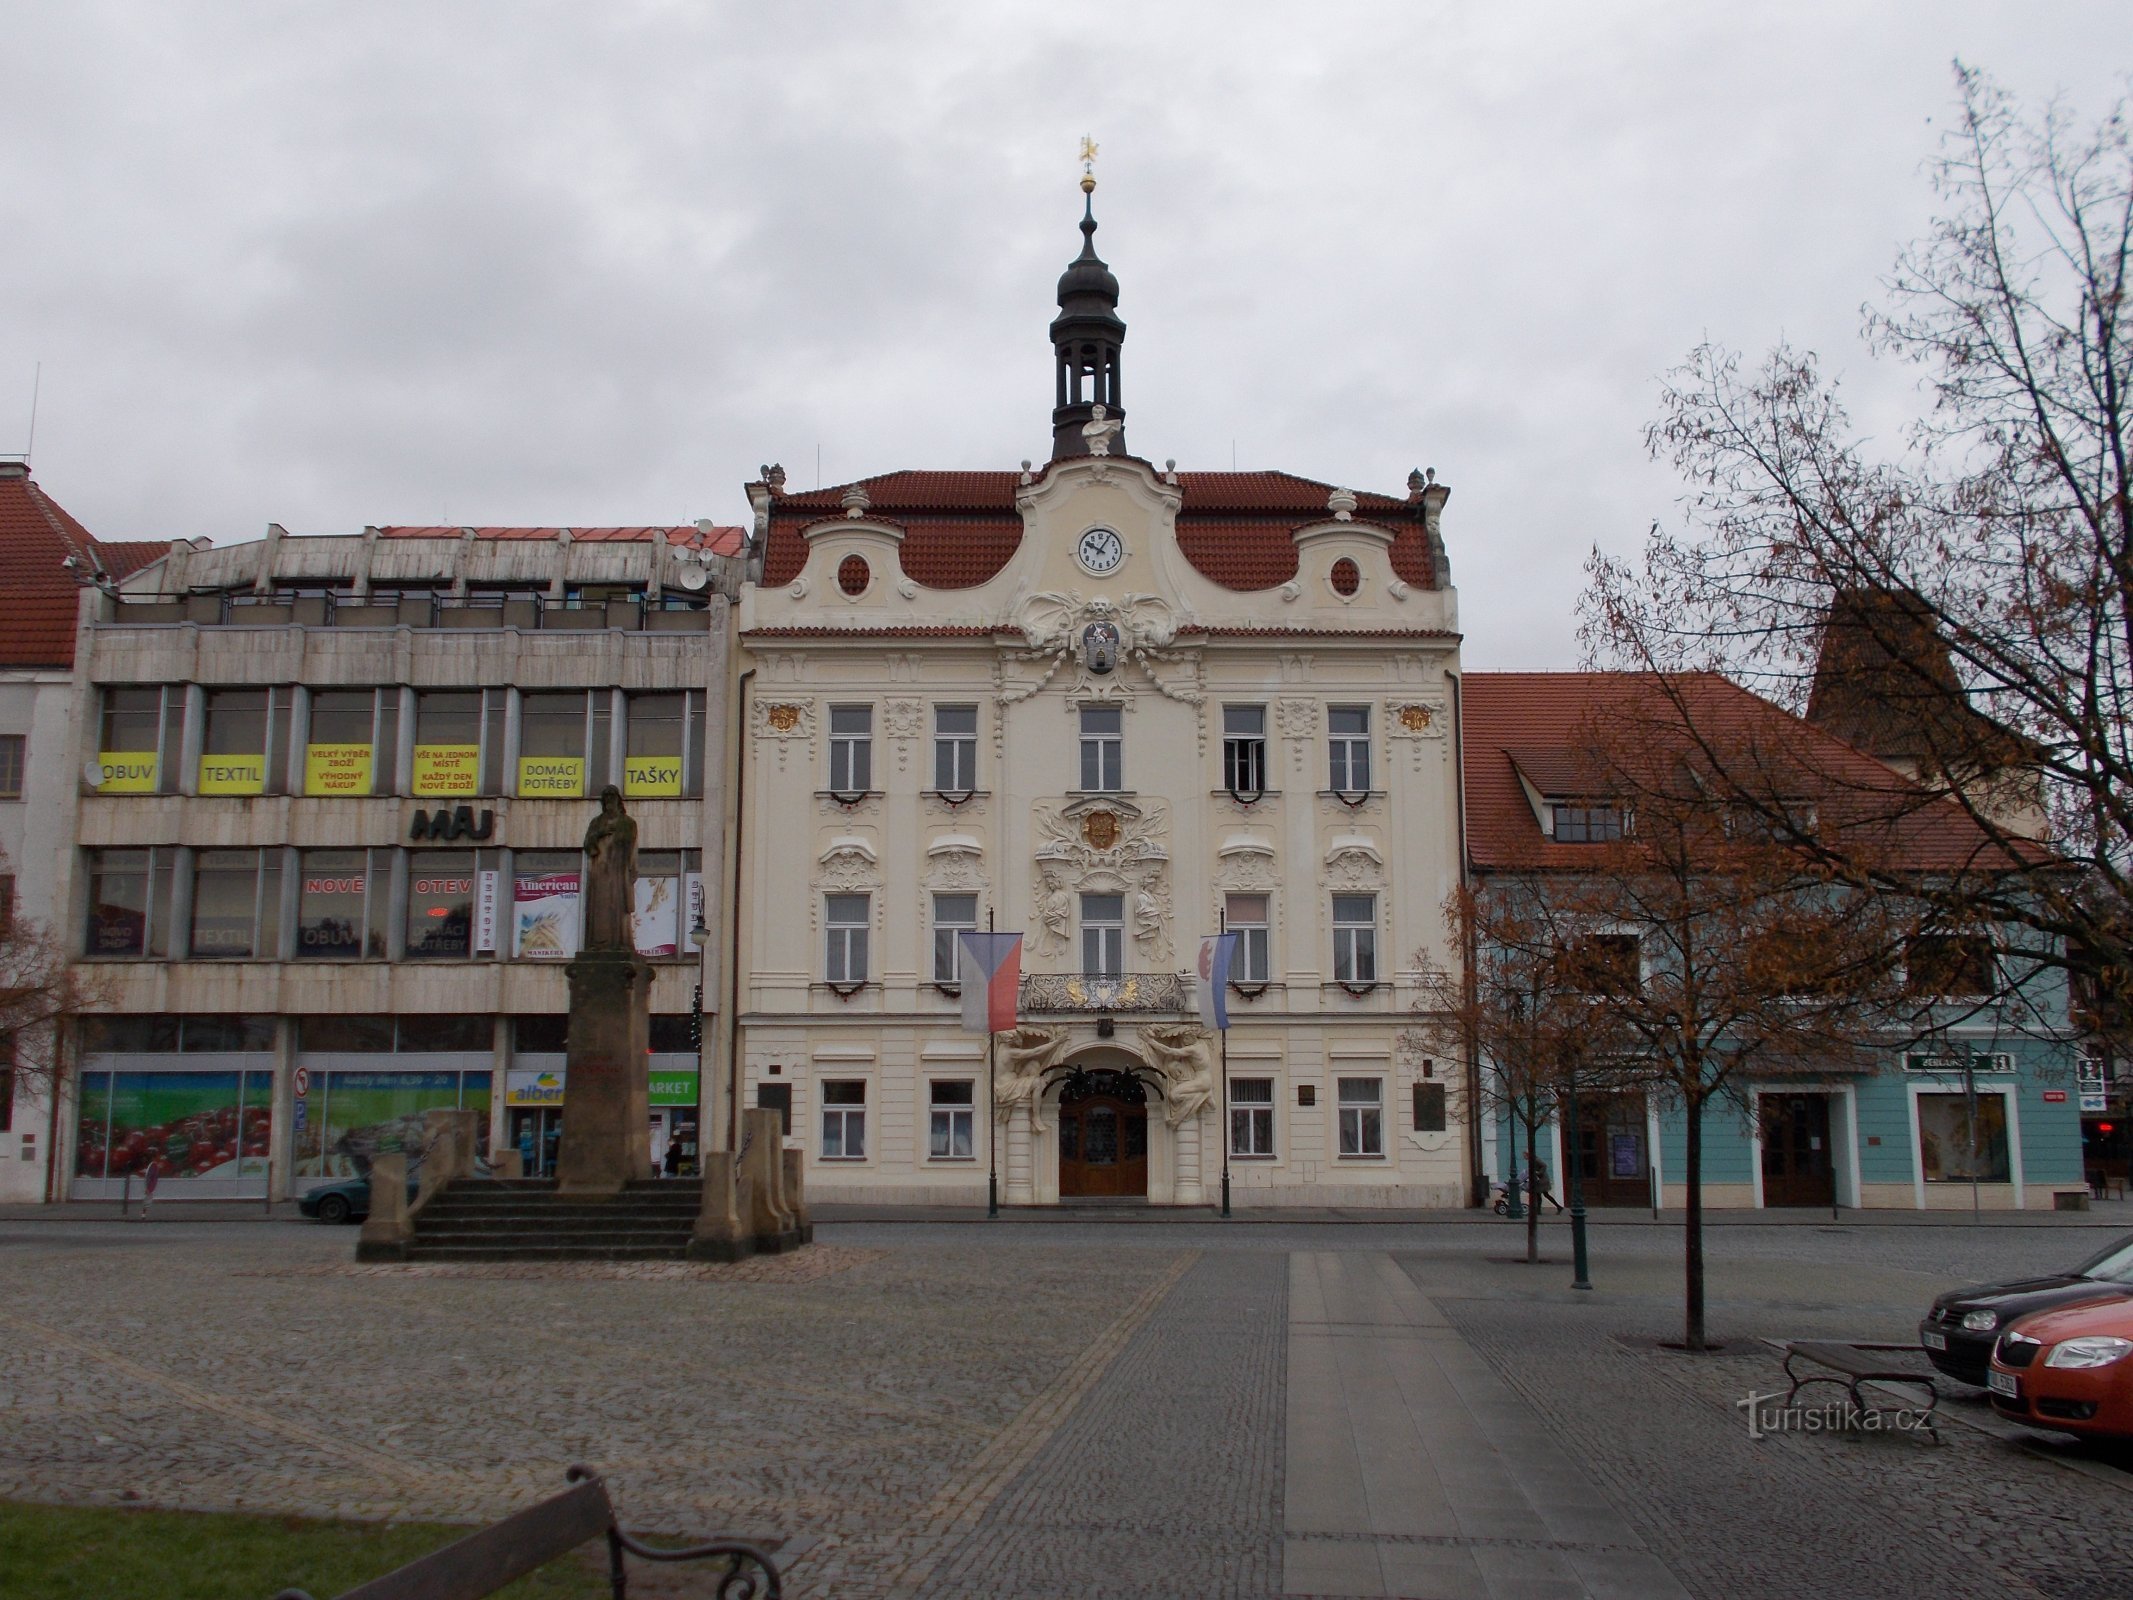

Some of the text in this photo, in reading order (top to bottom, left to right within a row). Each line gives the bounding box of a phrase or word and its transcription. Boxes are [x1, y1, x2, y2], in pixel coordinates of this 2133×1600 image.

[311, 749, 370, 758] VELKÝ VÝBĚR
[416, 750, 477, 759] VŠE NA JEDNOM
[328, 758, 354, 767] ZBOŽÍ
[432, 759, 460, 768] MÍSTĚ
[102, 765, 153, 780] OBUV
[526, 763, 577, 775] DOMÁCÍ
[205, 767, 262, 782] TEXTIL
[318, 771, 363, 780] VÝHODNÝ
[422, 771, 472, 781] KAŽDÝ DEN
[627, 766, 679, 784] TAŠKY
[324, 780, 357, 789] NÁKUP
[445, 780, 474, 789] ZBOŽÍ
[524, 776, 578, 789] POTŘEBY
[415, 879, 472, 894] OTEV
[520, 878, 578, 891] American
